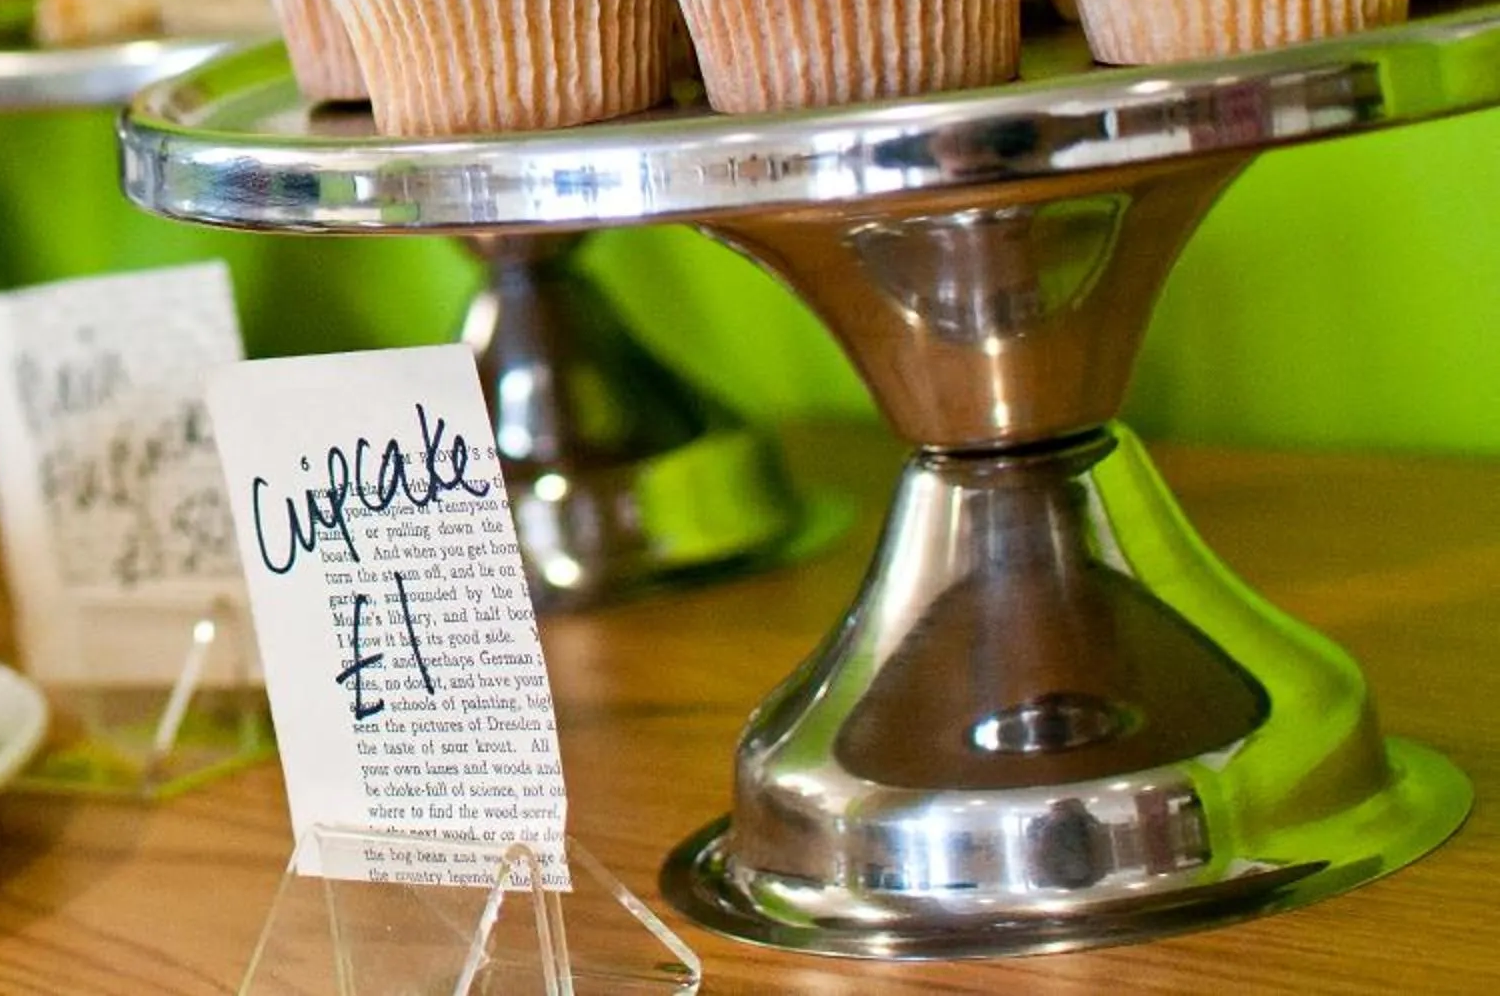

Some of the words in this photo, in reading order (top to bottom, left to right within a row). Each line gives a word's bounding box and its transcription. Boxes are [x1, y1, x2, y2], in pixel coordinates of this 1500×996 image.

[300, 456, 310, 471] 6
[252, 403, 492, 575] Cupcake
[365, 528, 379, 539] or
[386, 523, 431, 540] pulling
[438, 521, 473, 535] down
[481, 519, 503, 533] the
[374, 546, 400, 561] And
[403, 544, 438, 560] when
[440, 545, 465, 562] you
[468, 542, 489, 560] get
[325, 572, 352, 585] turn
[357, 567, 378, 582] the
[382, 569, 421, 582] stam
[450, 564, 475, 580] and
[478, 561, 495, 576] lie
[499, 565, 517, 576] on
[466, 589, 482, 603] by
[491, 584, 513, 599] the
[444, 608, 468, 623] and
[473, 604, 501, 621] half
[385, 632, 396, 647] it
[427, 631, 444, 645] its
[448, 628, 481, 648] good
[485, 627, 515, 644] side.
[393, 654, 417, 668] and
[385, 679, 401, 691] no
[450, 674, 474, 690] and
[478, 673, 509, 687] have
[514, 673, 544, 691] your
[390, 696, 437, 711] schools
[441, 697, 455, 710] of
[461, 695, 522, 714] painting,
[352, 723, 380, 733] seen
[385, 718, 406, 733] the
[411, 720, 464, 736] pictures
[468, 718, 482, 731] of
[487, 716, 541, 731] Dresden
[357, 742, 377, 755] the
[383, 743, 415, 754] taste
[421, 742, 434, 754] of
[441, 744, 469, 754] sour
[531, 739, 549, 753] All
[361, 765, 389, 778] your
[393, 765, 422, 775] own
[425, 762, 459, 775] lanes
[464, 760, 489, 775] and
[493, 760, 533, 774] woods
[365, 785, 381, 797] be
[383, 782, 449, 797] choke-full
[451, 782, 465, 797] of
[469, 782, 519, 799] science,
[523, 785, 544, 797] not
[368, 803, 405, 819] where
[411, 805, 424, 819] to
[428, 803, 453, 819] find
[459, 803, 479, 819] the
[483, 830, 496, 841] or
[519, 826, 539, 841] the
[365, 848, 383, 861] the
[369, 869, 389, 883] the
